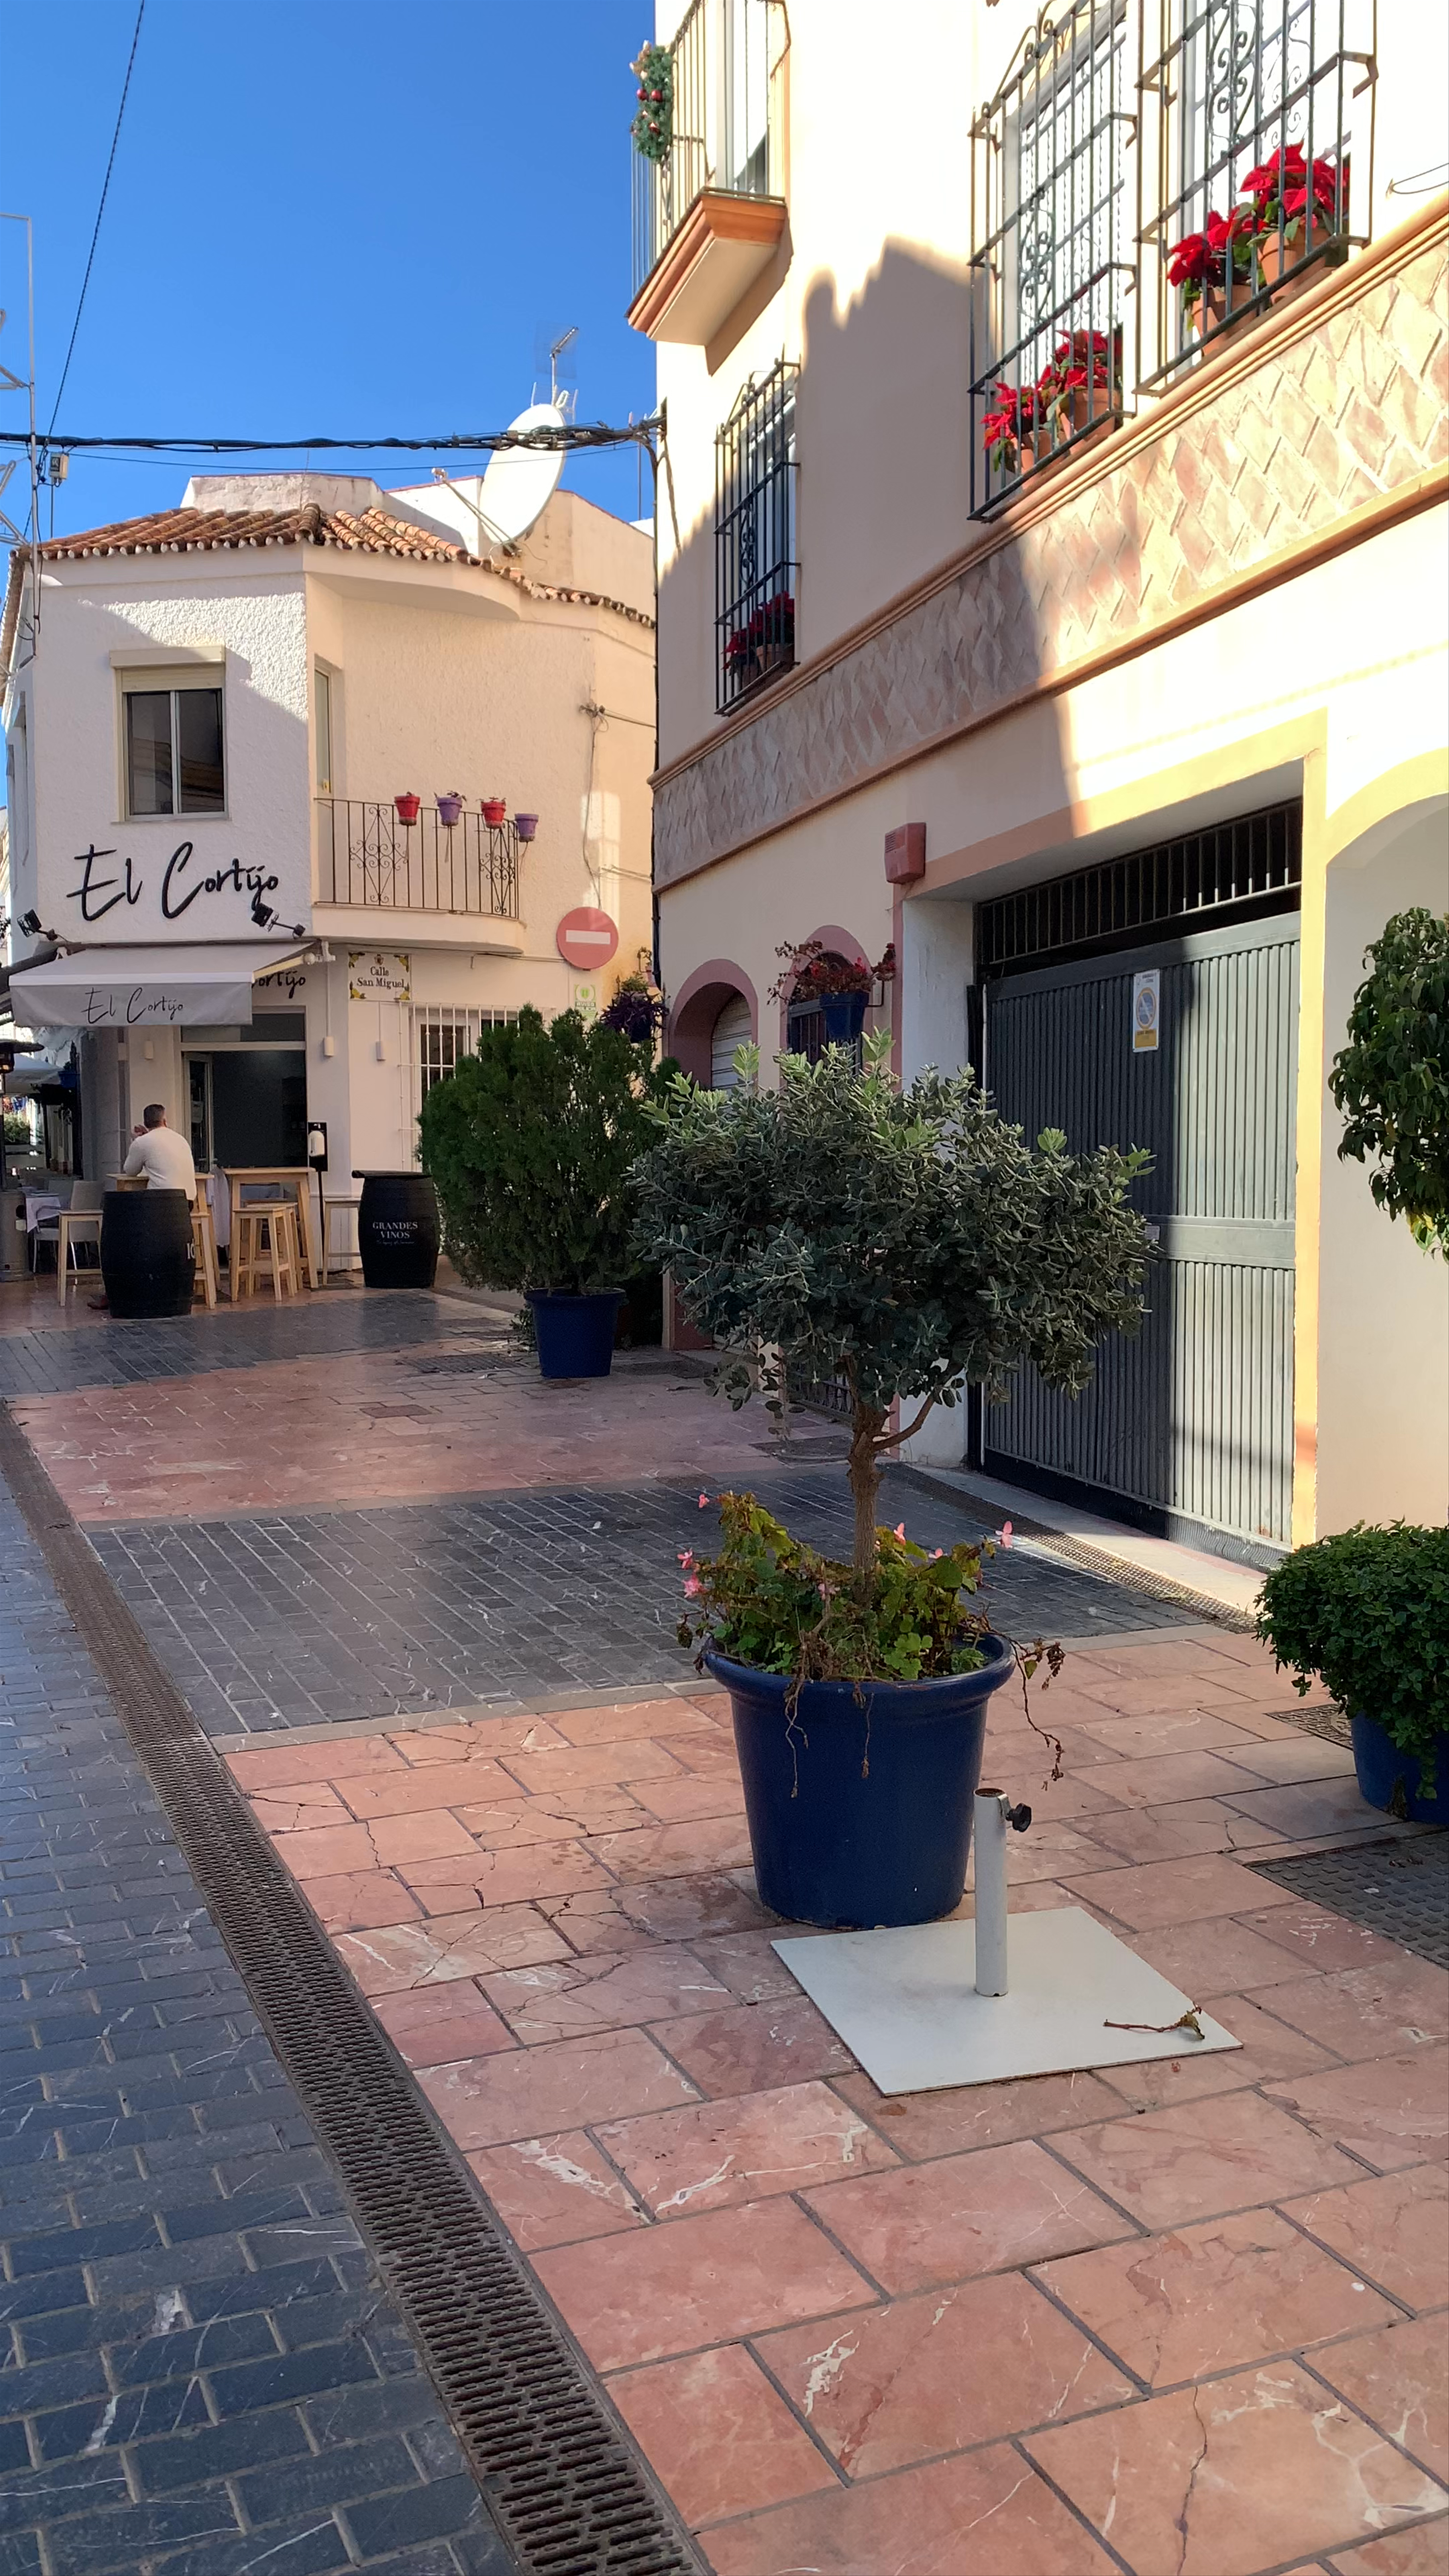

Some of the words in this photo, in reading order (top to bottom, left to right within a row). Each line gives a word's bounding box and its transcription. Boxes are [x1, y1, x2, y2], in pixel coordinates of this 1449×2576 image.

[66, 844, 143, 921] El
[162, 841, 279, 919] Cortijo
[370, 966, 389, 977] Calle
[252, 970, 306, 999] ortijo
[357, 977, 374, 986] San
[376, 978, 404, 989] Miguel
[80, 987, 116, 1024] El
[127, 987, 183, 1024] Cortijo
[372, 1221, 418, 1230] GRANDES
